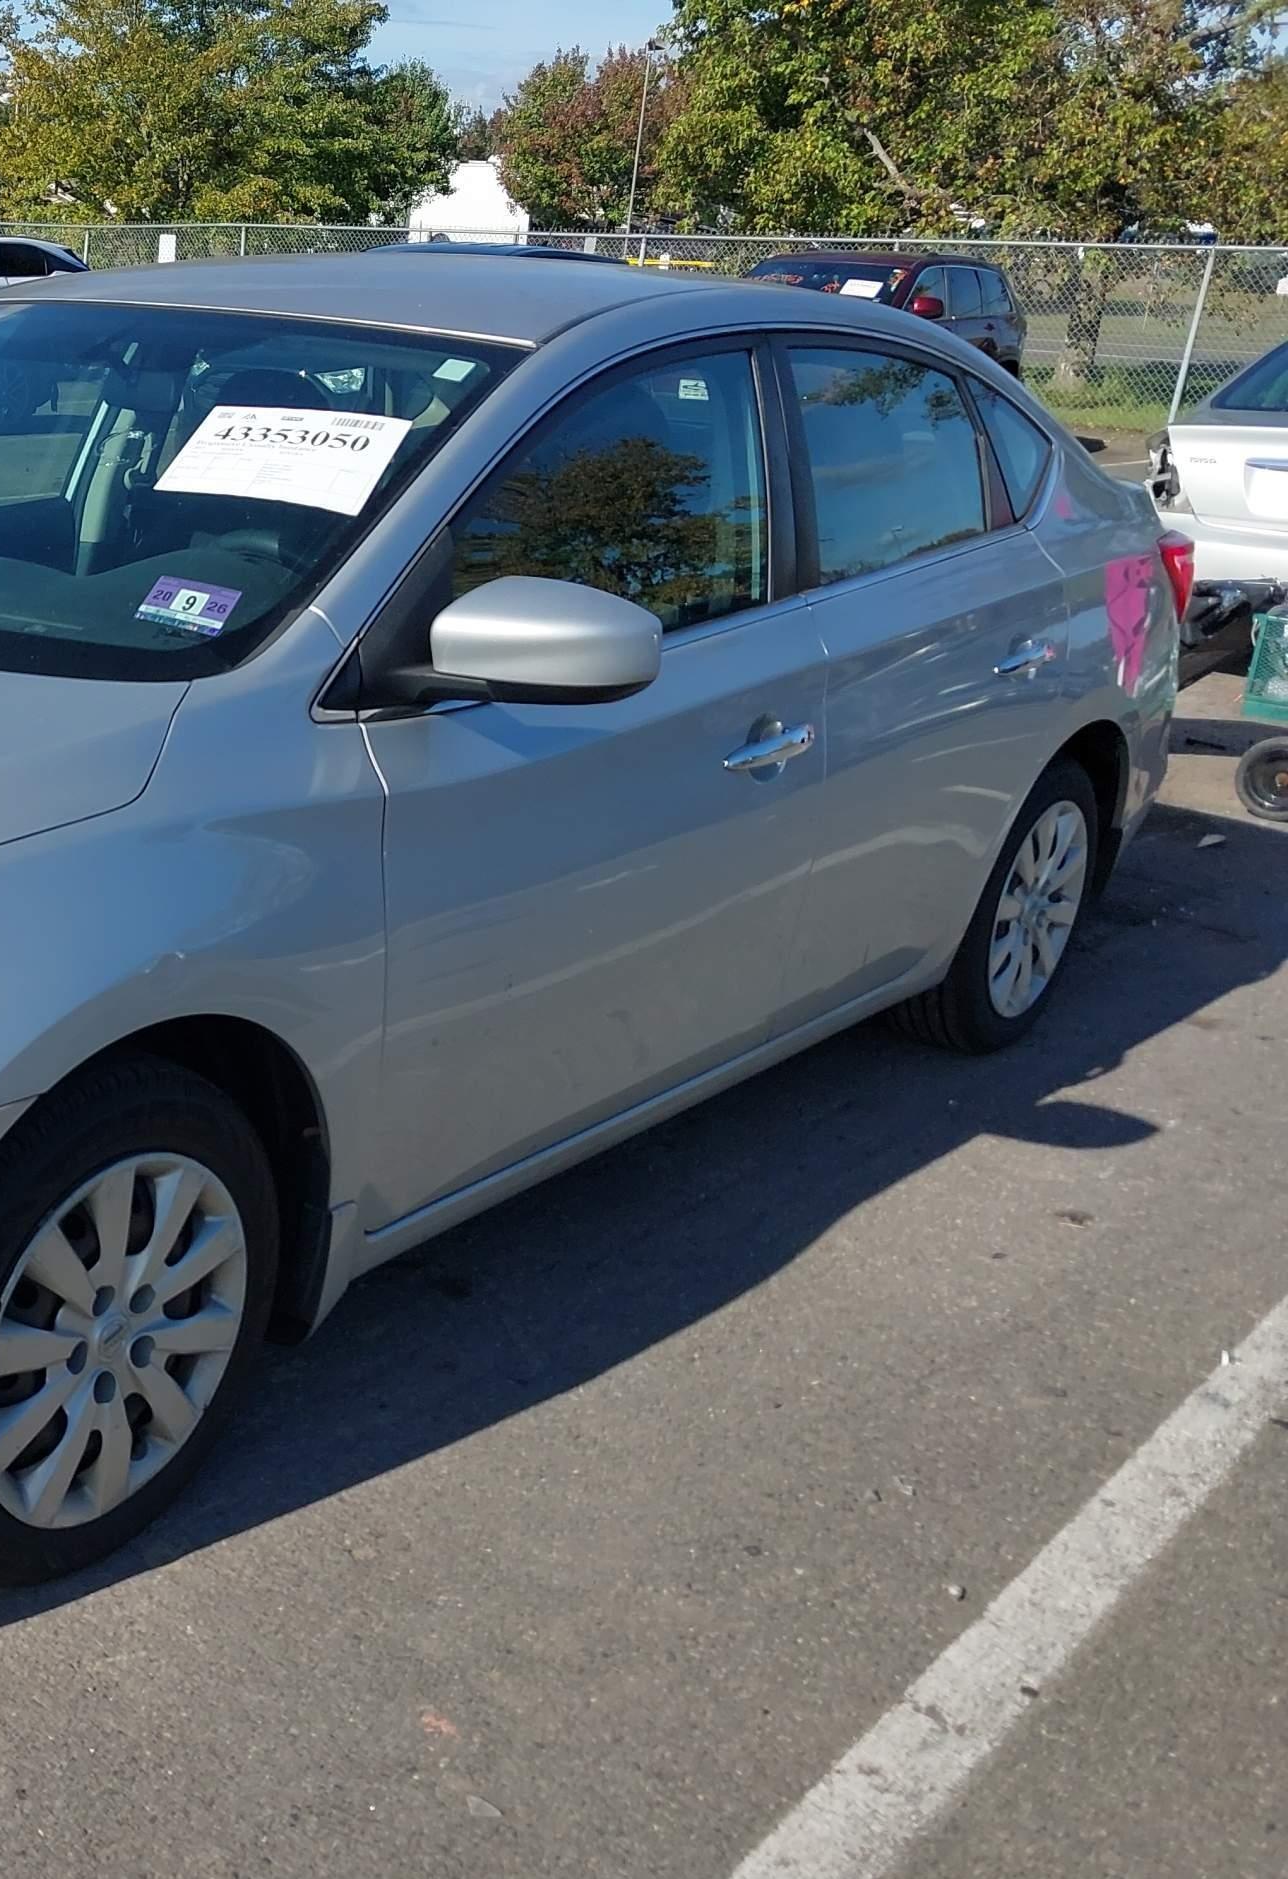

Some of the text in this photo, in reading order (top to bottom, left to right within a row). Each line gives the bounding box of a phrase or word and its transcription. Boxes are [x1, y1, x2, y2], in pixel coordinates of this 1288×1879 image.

[214, 425, 370, 452] 43353050
[153, 589, 229, 614] 20 9 26
